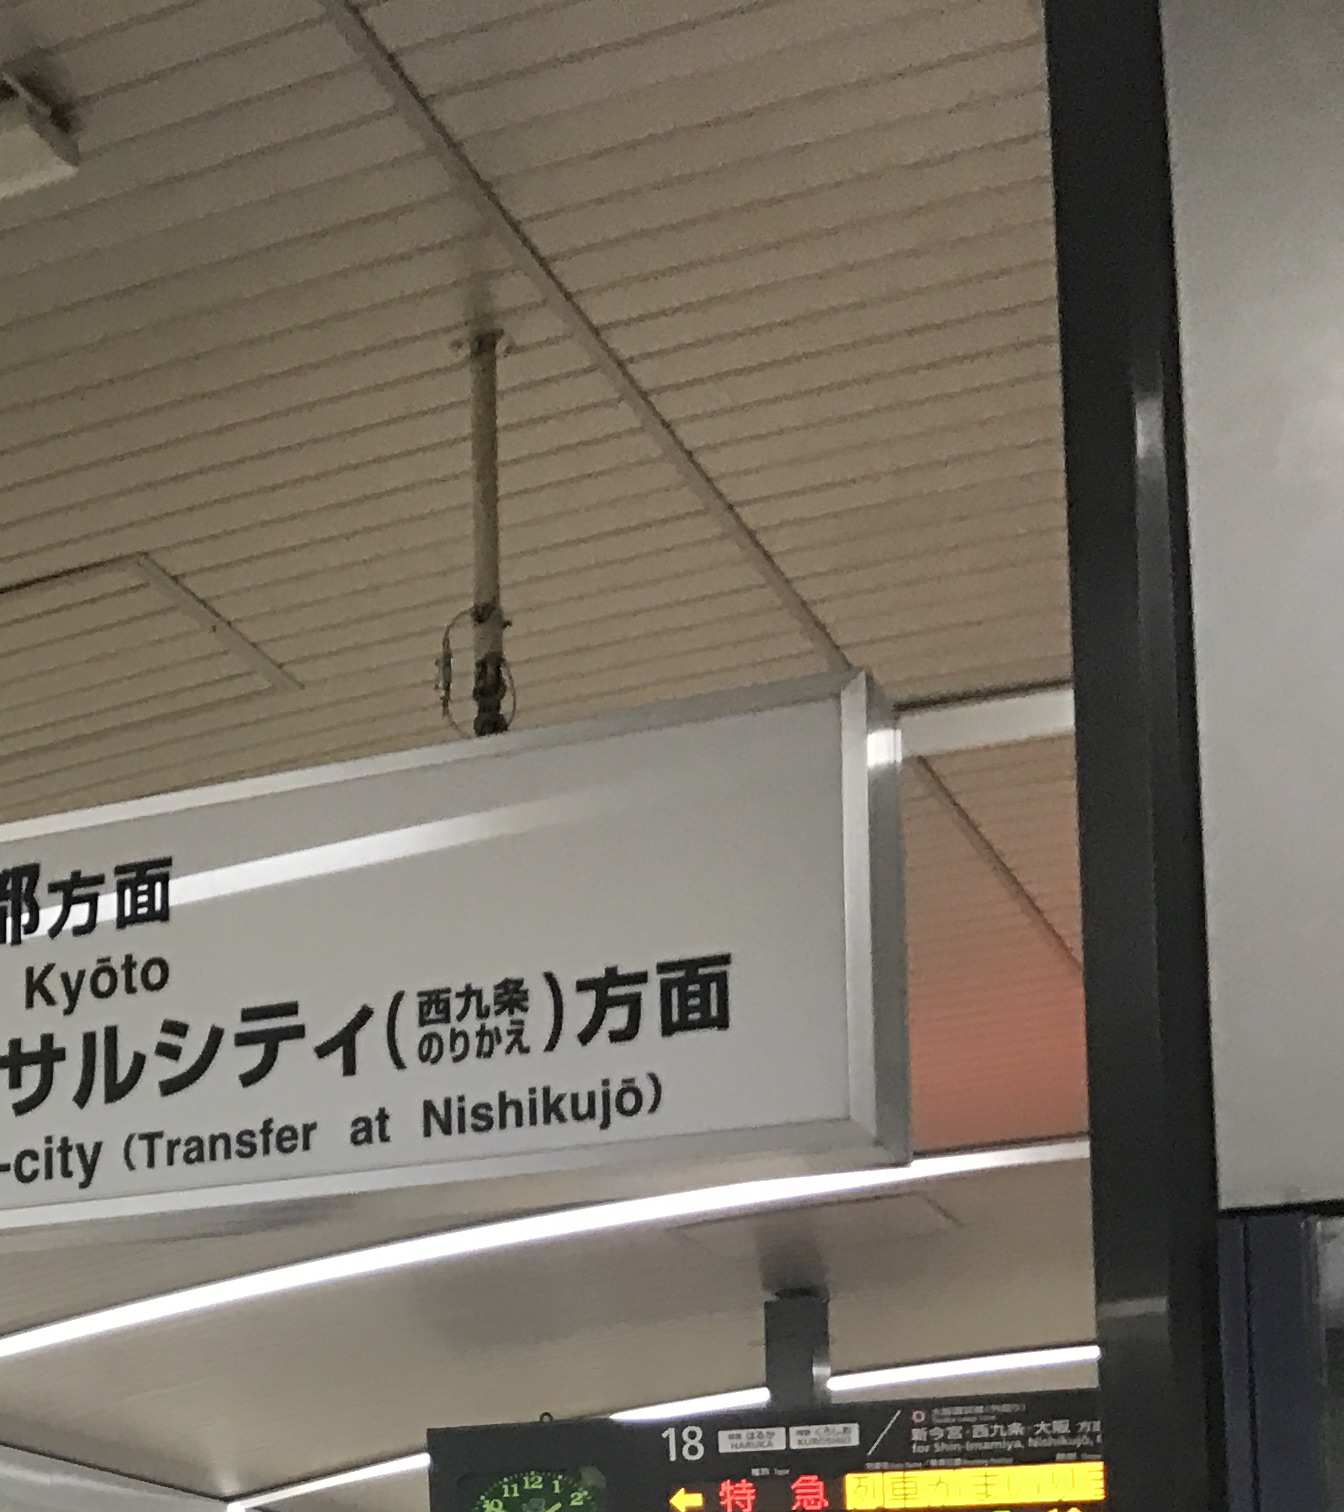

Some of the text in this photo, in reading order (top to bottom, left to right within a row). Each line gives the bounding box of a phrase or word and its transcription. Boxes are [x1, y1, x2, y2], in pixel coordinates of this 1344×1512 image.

[25, 951, 170, 1009] Kyōto
[124, 1115, 318, 1172] (Transfer
[351, 1107, 391, 1146] at
[423, 1071, 664, 1139] Nishikujō)
[662, 1425, 705, 1462] 18
[523, 1475, 544, 1490] 12
[552, 1479, 561, 1494] 1
[502, 1483, 520, 1498] 11
[570, 1492, 584, 1506] 2
